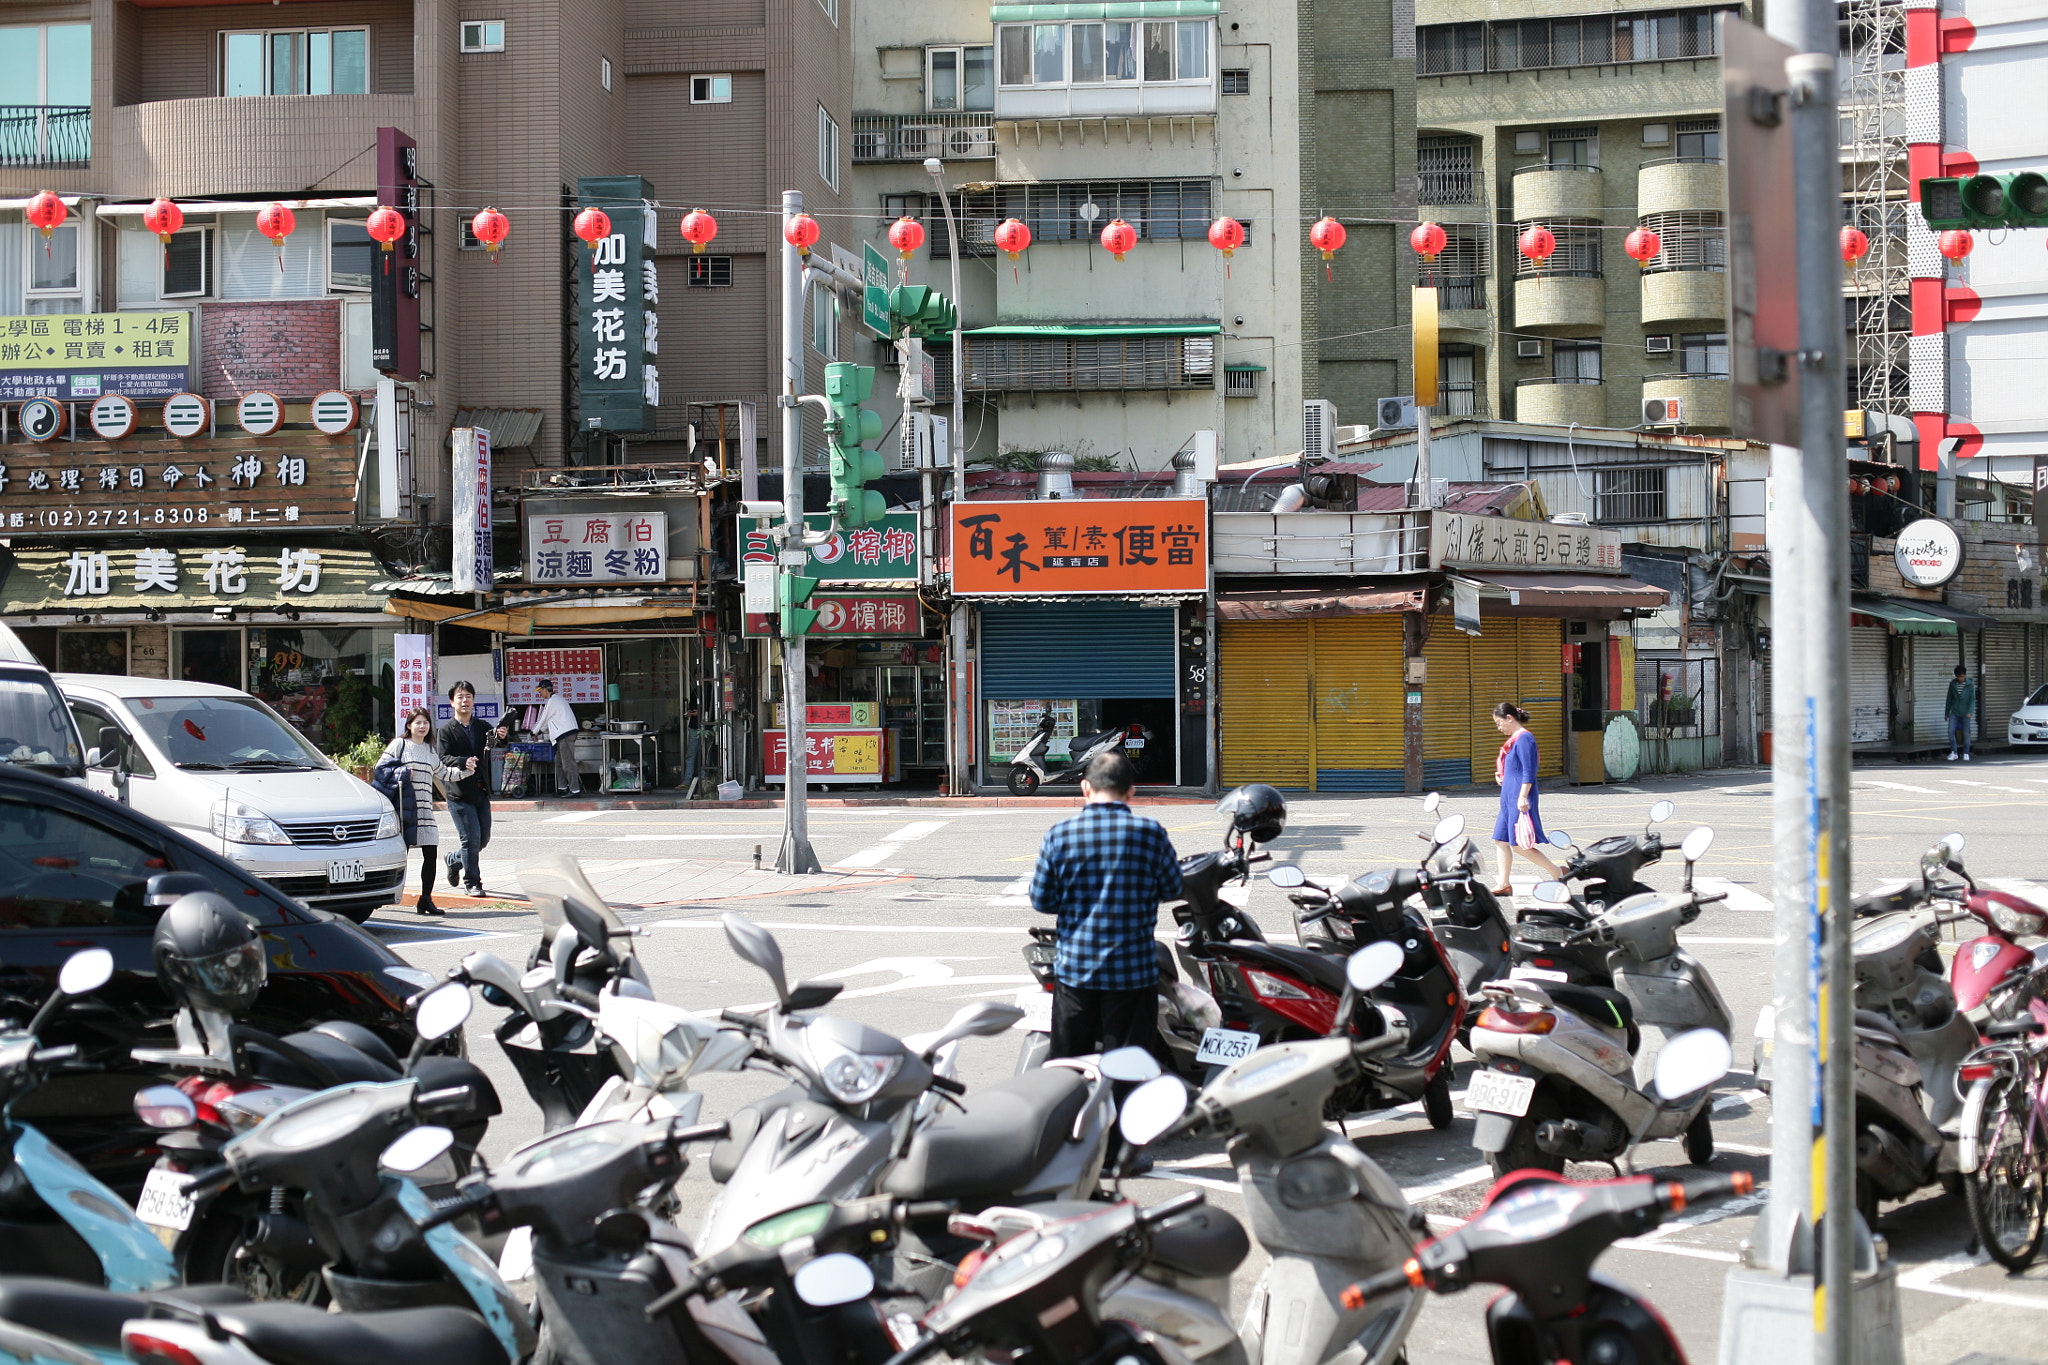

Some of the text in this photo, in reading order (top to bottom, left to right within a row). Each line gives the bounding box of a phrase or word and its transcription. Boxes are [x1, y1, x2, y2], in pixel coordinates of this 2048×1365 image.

[593, 233, 627, 380] 加美花坊
[0, 319, 50, 338] 學區
[64, 341, 105, 359] 買賣
[133, 340, 174, 358] 租賃
[74, 376, 98, 386] 住商
[231, 454, 307, 488] 神相
[477, 433, 489, 528] 豆腐伯
[228, 505, 299, 523] 請上二樓
[542, 518, 652, 544] 豆腐伯
[848, 527, 916, 566] 檳榔
[959, 513, 1040, 583] 百禾
[1113, 524, 1200, 566] 便當
[64, 547, 322, 596] 加美花坊
[537, 548, 660, 579] 涼麵 冬粉
[1052, 557, 1099, 568] 延吉店
[851, 601, 907, 630] 檳榔
[1188, 664, 1205, 682] 58
